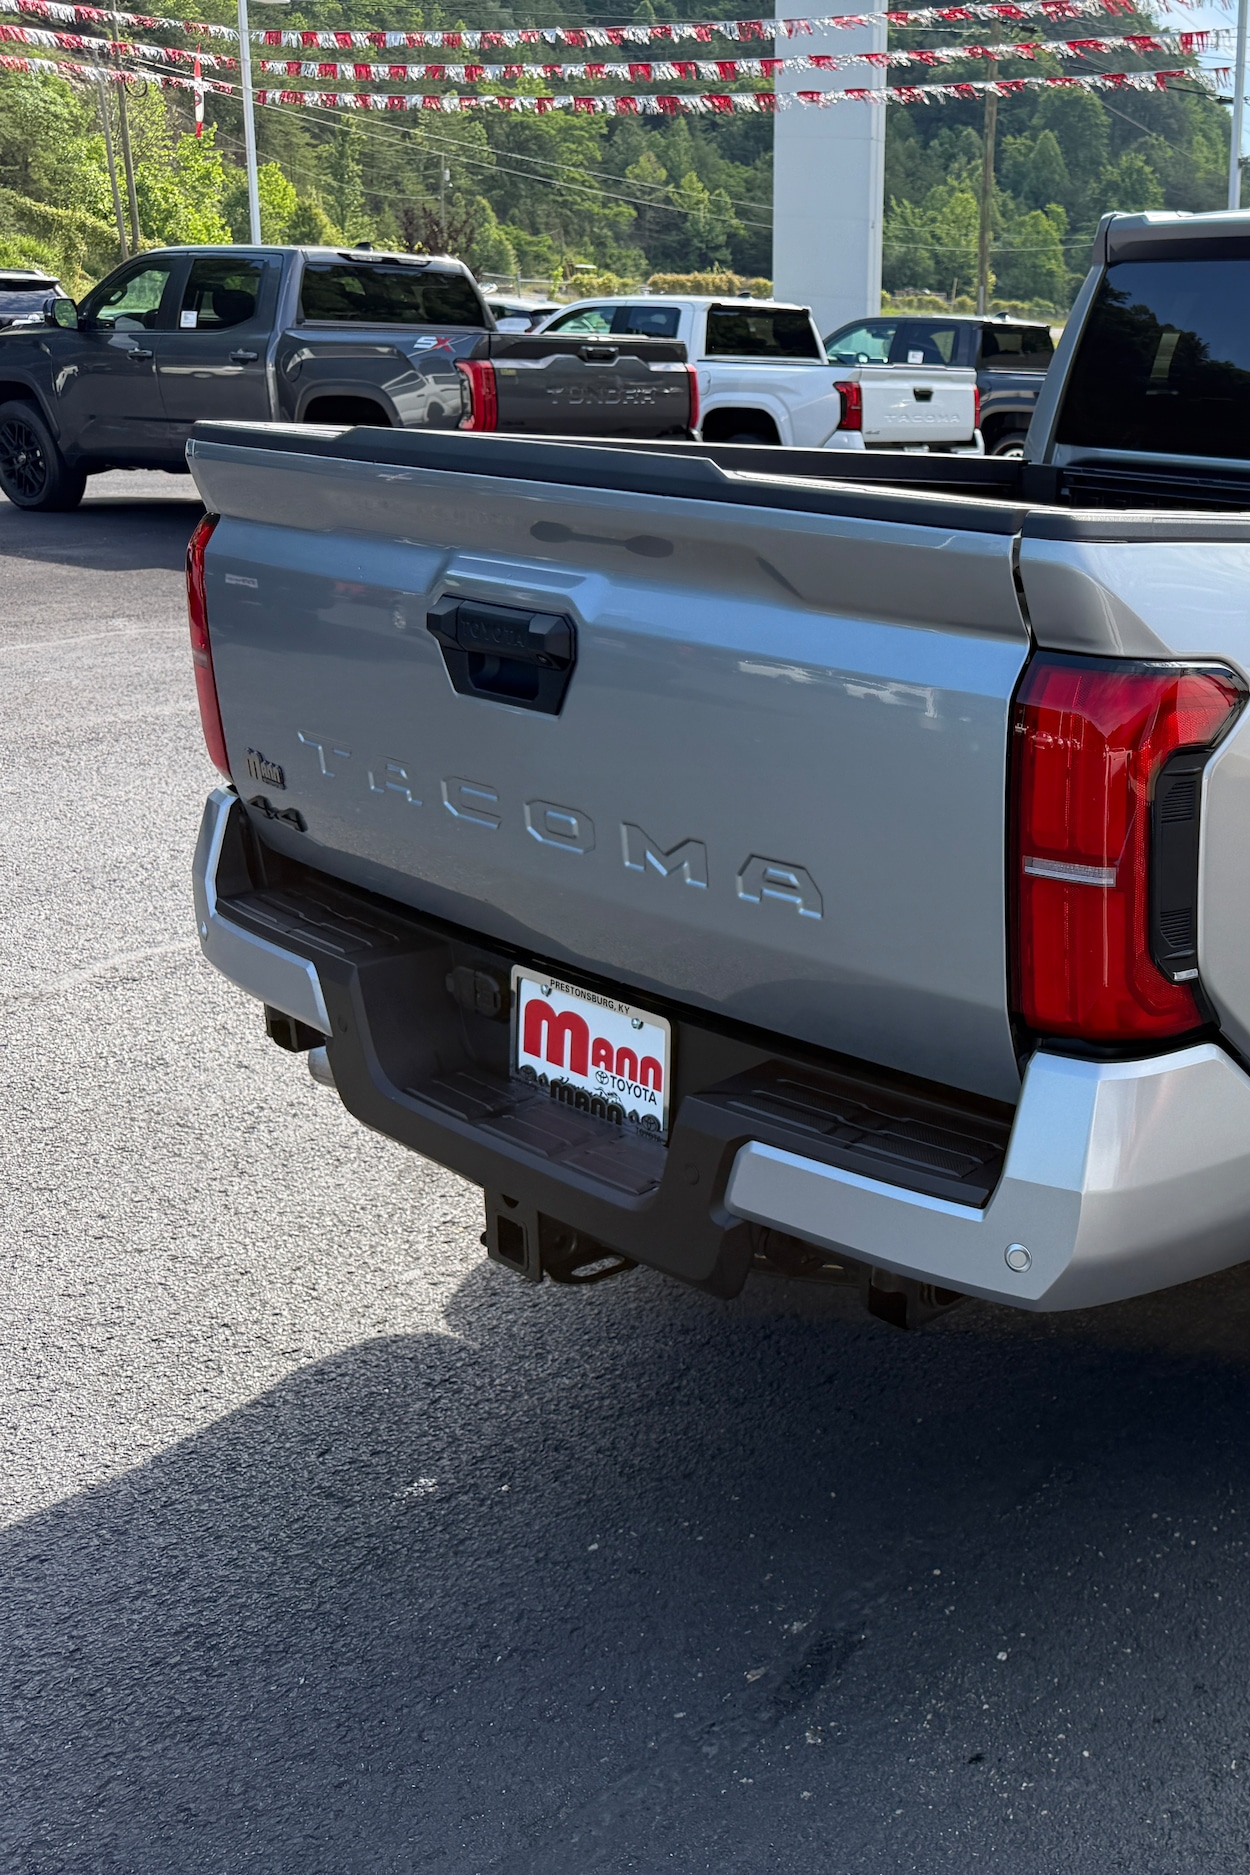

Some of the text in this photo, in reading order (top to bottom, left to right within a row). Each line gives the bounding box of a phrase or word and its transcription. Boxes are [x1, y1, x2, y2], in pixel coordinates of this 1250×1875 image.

[884, 414, 960, 423] TACOMA
[297, 730, 824, 919] TACOMA
[550, 979, 630, 1015] PRESTONSBURG, KY
[610, 1075, 658, 1105] TOYOTA
